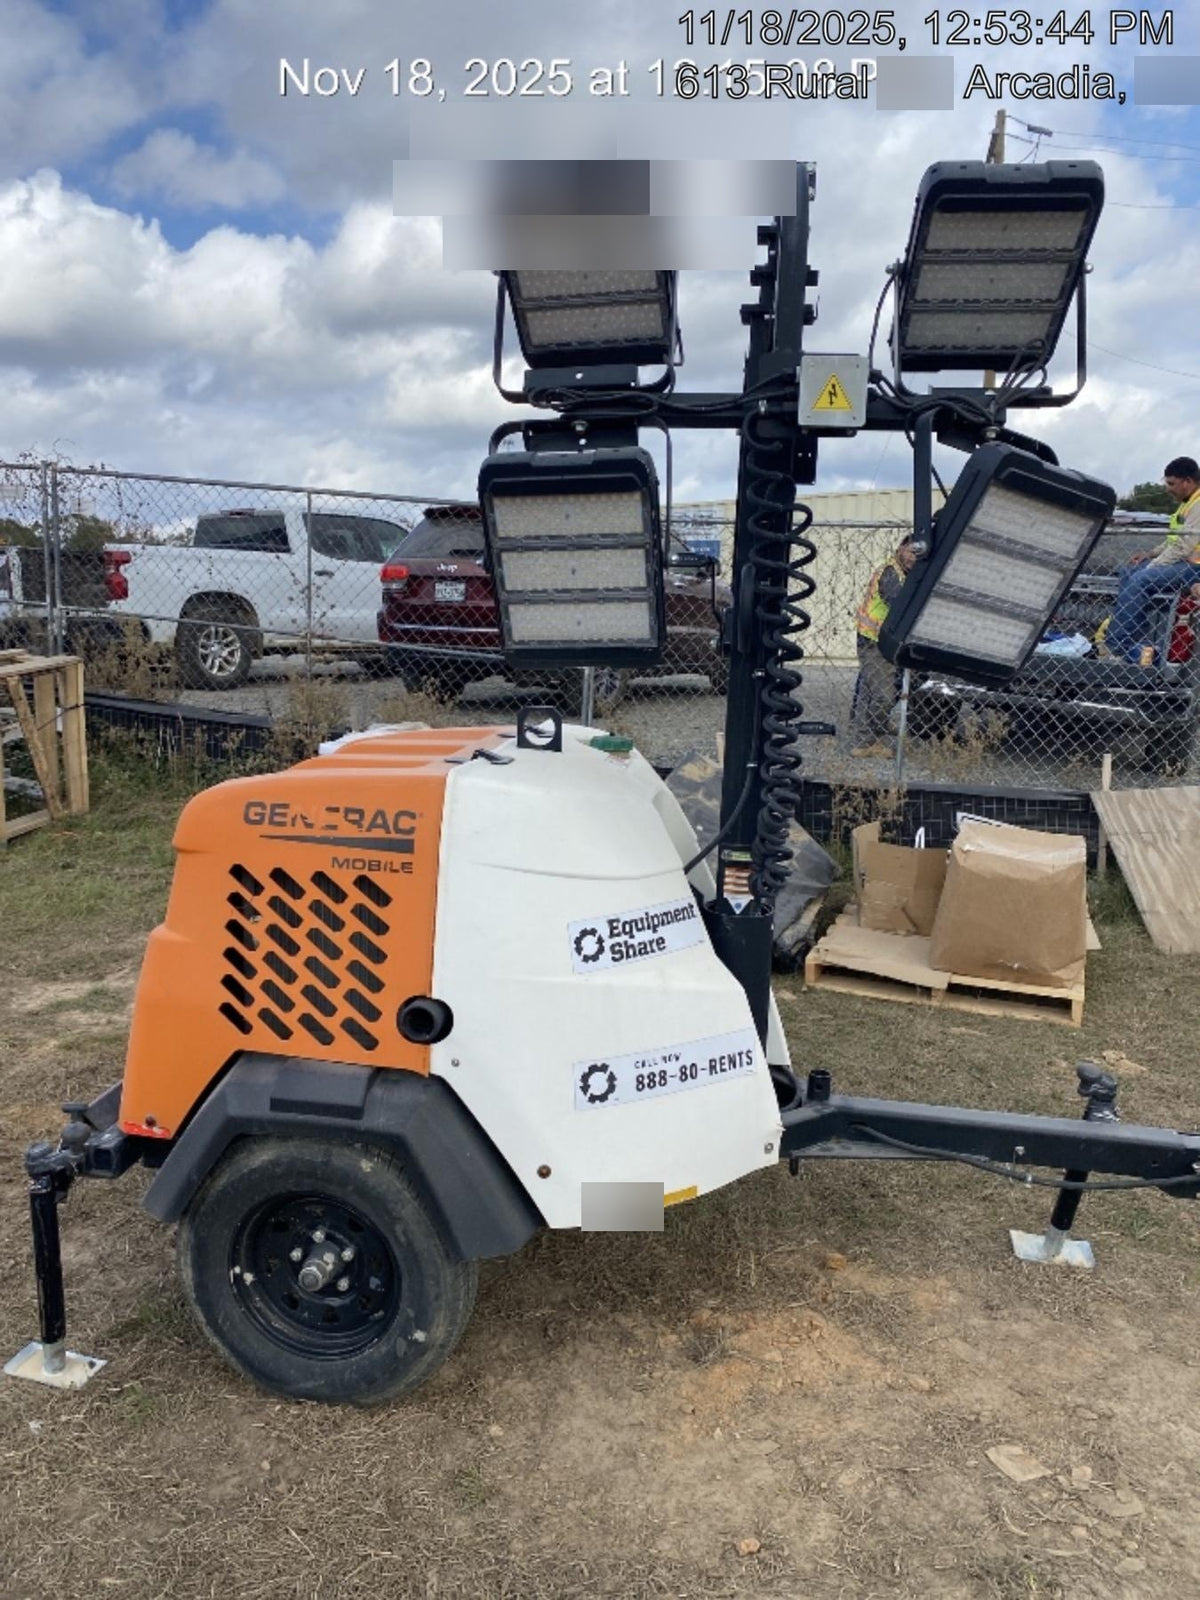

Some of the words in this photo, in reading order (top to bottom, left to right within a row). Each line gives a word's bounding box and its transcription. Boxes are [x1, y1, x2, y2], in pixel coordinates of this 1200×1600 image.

[331, 856, 414, 875] MOBILE
[606, 902, 697, 940] Equipment
[608, 935, 667, 963] Share
[634, 1049, 754, 1093] 888-80-RENTS
